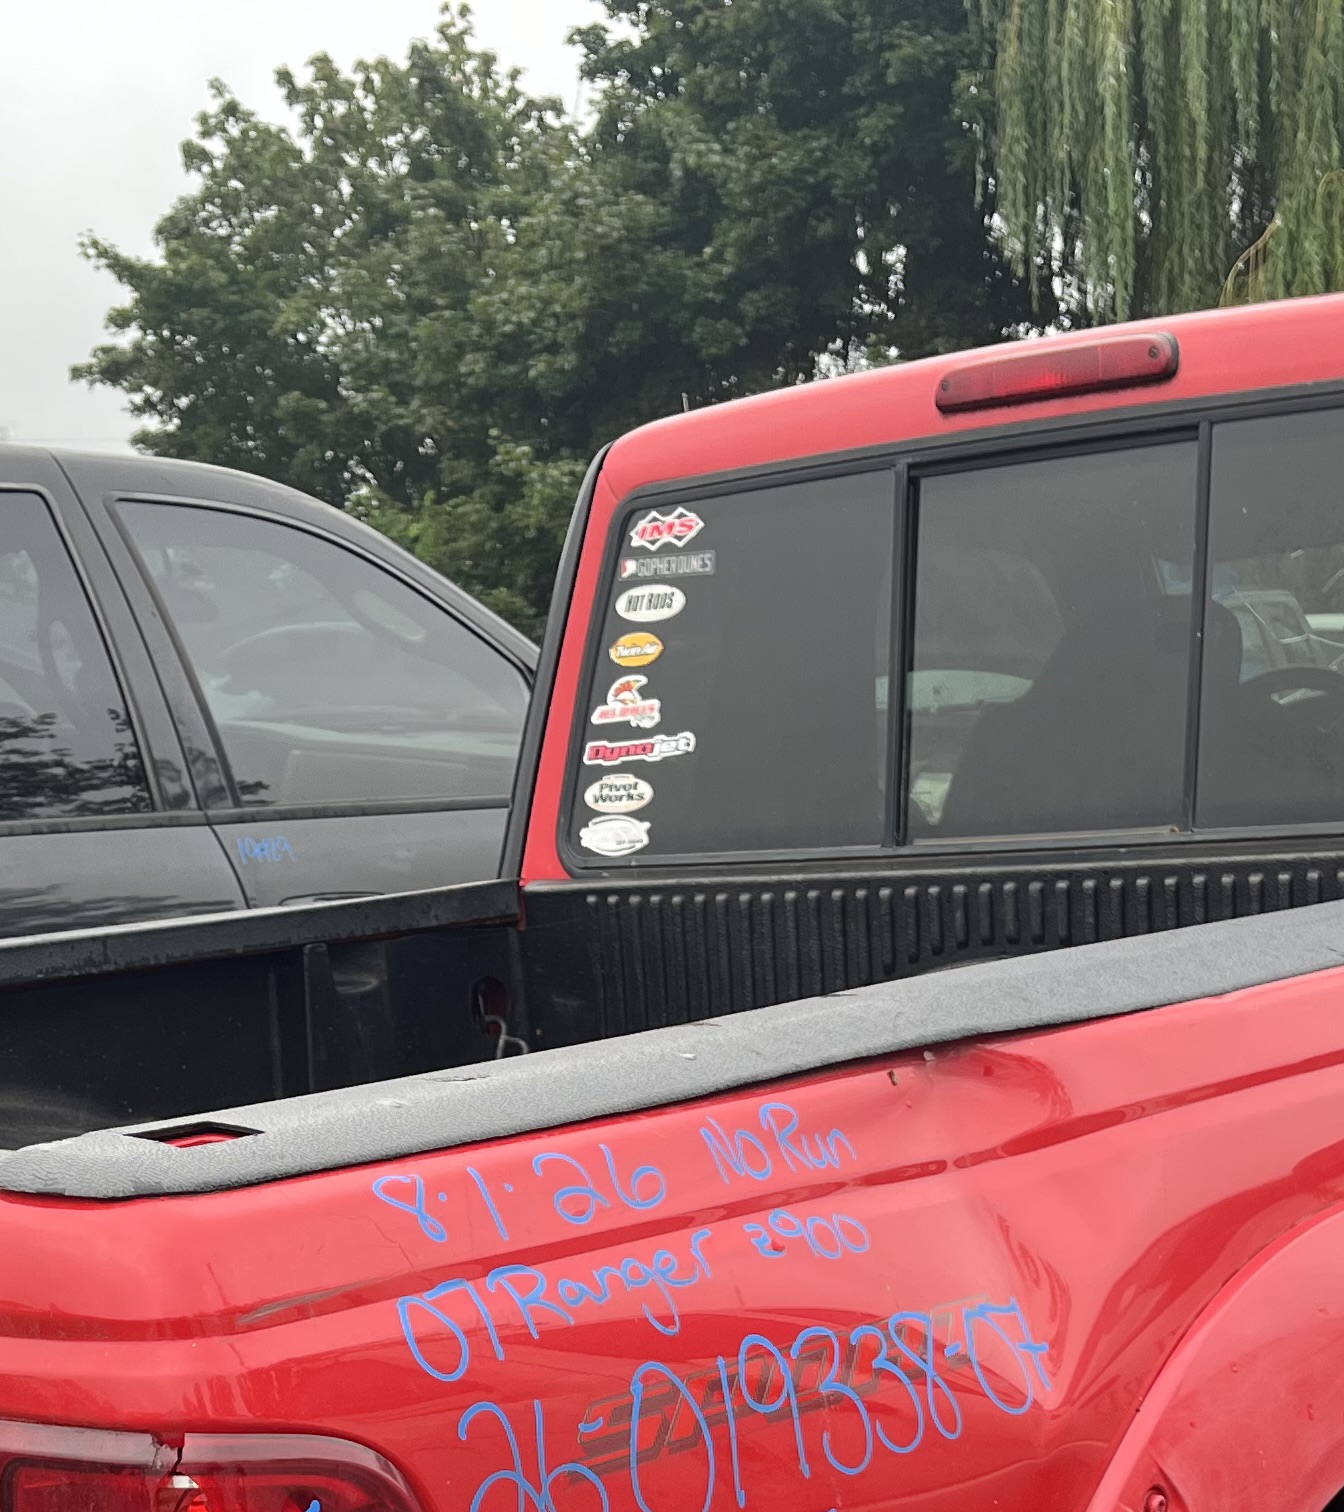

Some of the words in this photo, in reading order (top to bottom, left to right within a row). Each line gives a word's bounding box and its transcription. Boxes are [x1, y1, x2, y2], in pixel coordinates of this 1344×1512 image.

[637, 517, 697, 541] IMS
[588, 735, 693, 762] Dynajet
[592, 791, 645, 804] Works
[598, 781, 639, 793] Pivot
[487, 1229, 713, 1336] Ranger
